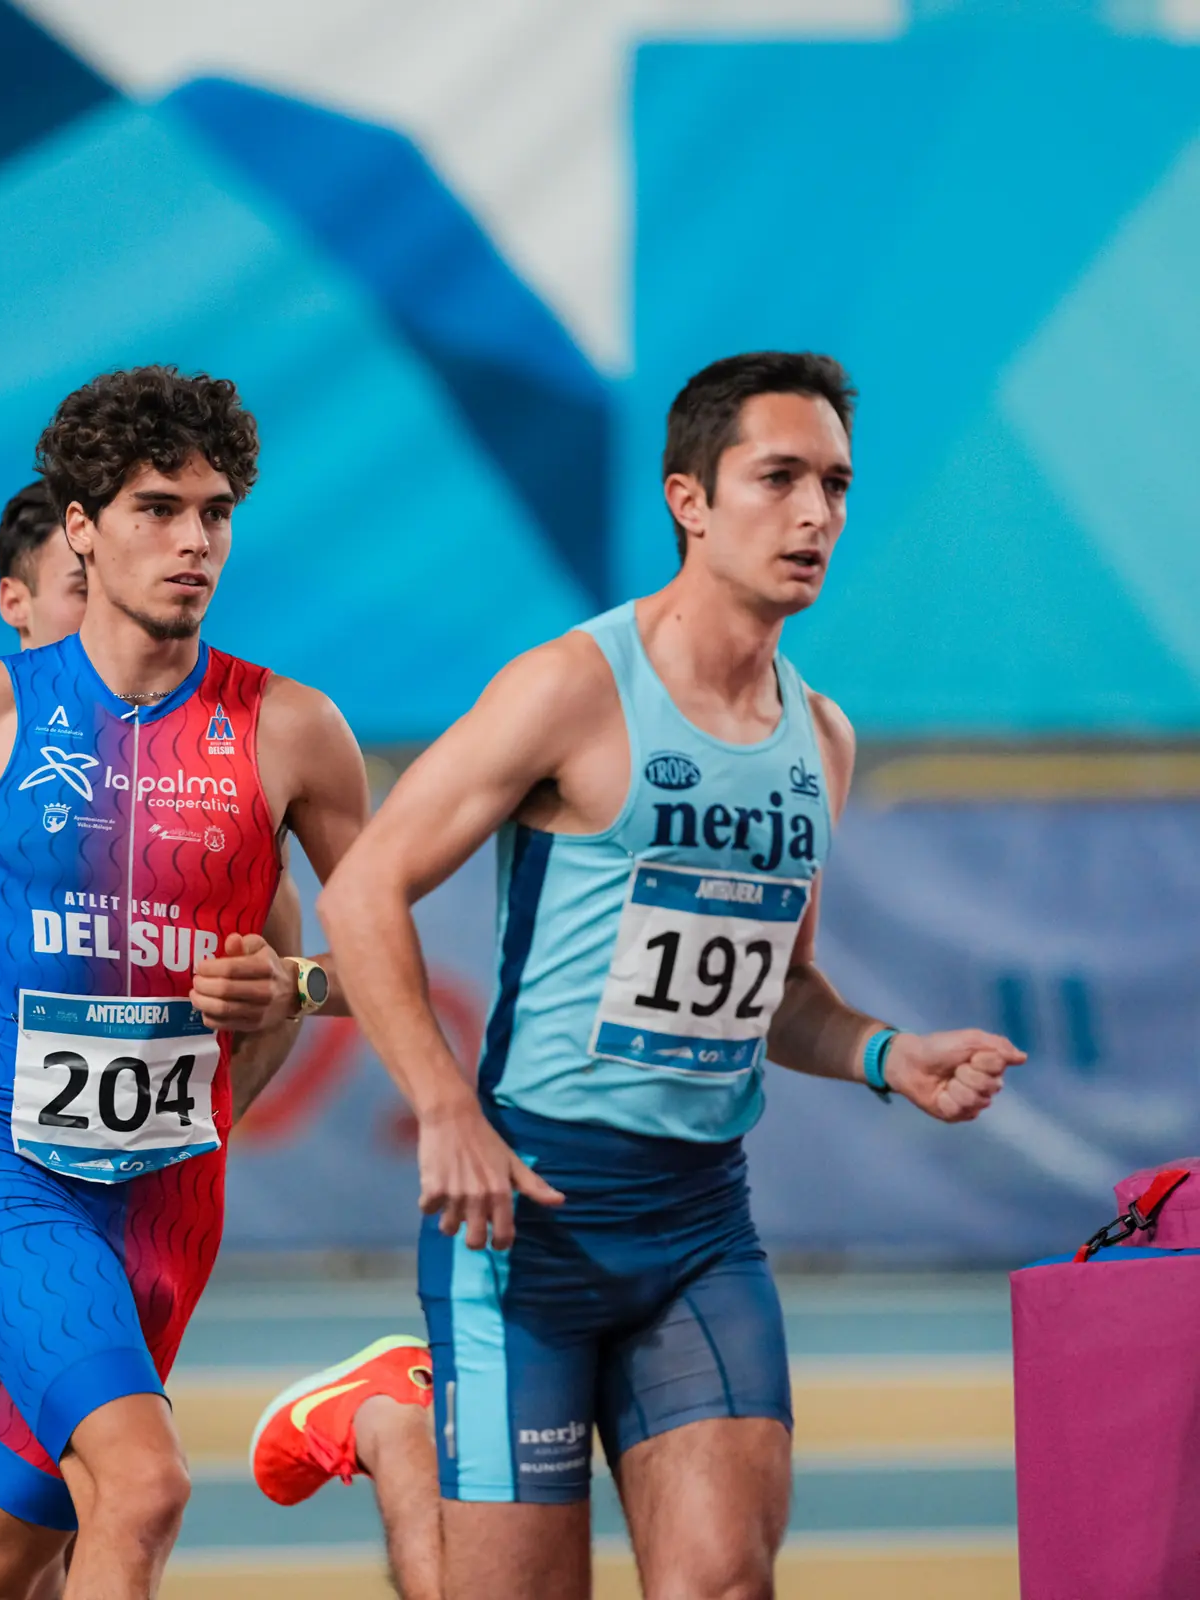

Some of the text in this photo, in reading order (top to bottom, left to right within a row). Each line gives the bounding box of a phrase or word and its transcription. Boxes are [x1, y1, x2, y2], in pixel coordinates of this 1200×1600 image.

[648, 757, 701, 786] TROPS
[147, 797, 241, 815] cooperativa
[649, 790, 815, 872] nerja
[695, 878, 764, 906] ANTEQUERA
[634, 929, 773, 1020] 192
[86, 1004, 170, 1025] ANTEQUERA
[38, 1050, 196, 1132] 204
